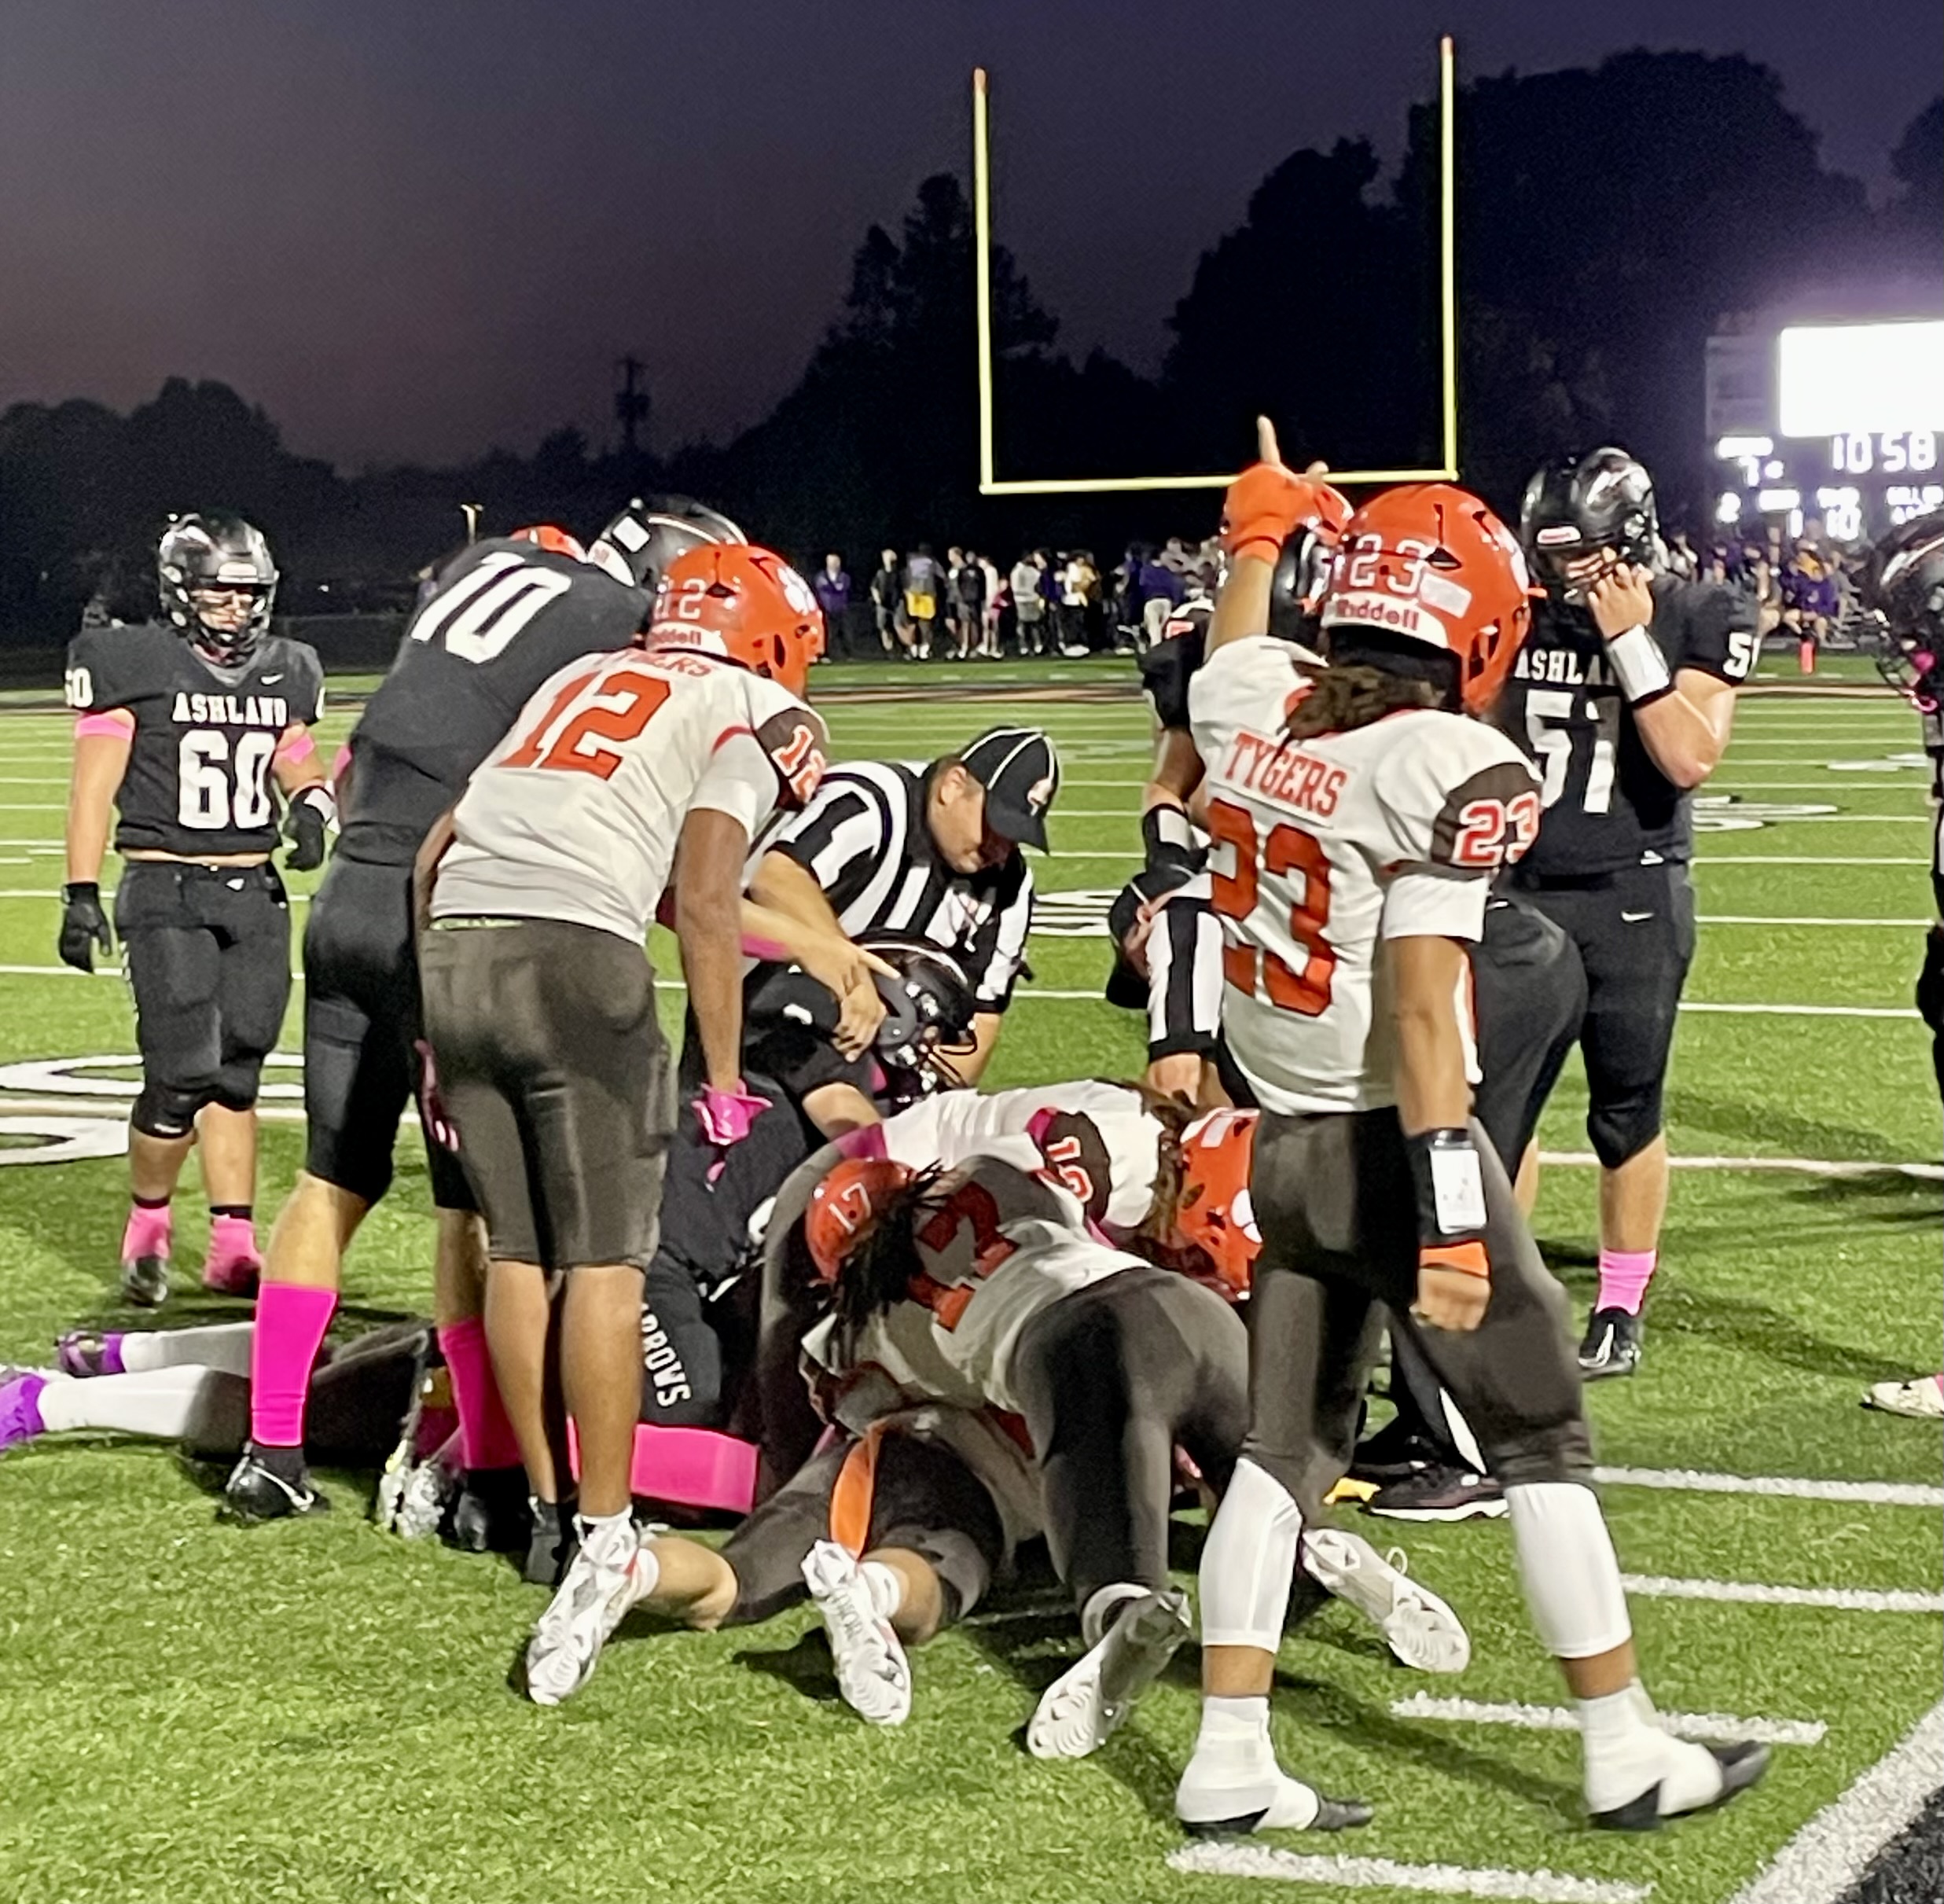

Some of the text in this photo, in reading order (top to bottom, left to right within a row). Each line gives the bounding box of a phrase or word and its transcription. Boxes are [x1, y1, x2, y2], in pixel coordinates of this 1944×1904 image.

[1832, 432, 1872, 473] 10
[1349, 534, 1431, 595] 23
[411, 551, 572, 663] 10
[172, 692, 287, 727] ASHLAND
[491, 671, 671, 781] 12
[178, 730, 276, 829] 60
[1224, 731, 1348, 818] TYGERS
[1453, 792, 1540, 866] 23
[1207, 796, 1336, 1016] 23
[828, 1182, 872, 1234] 17
